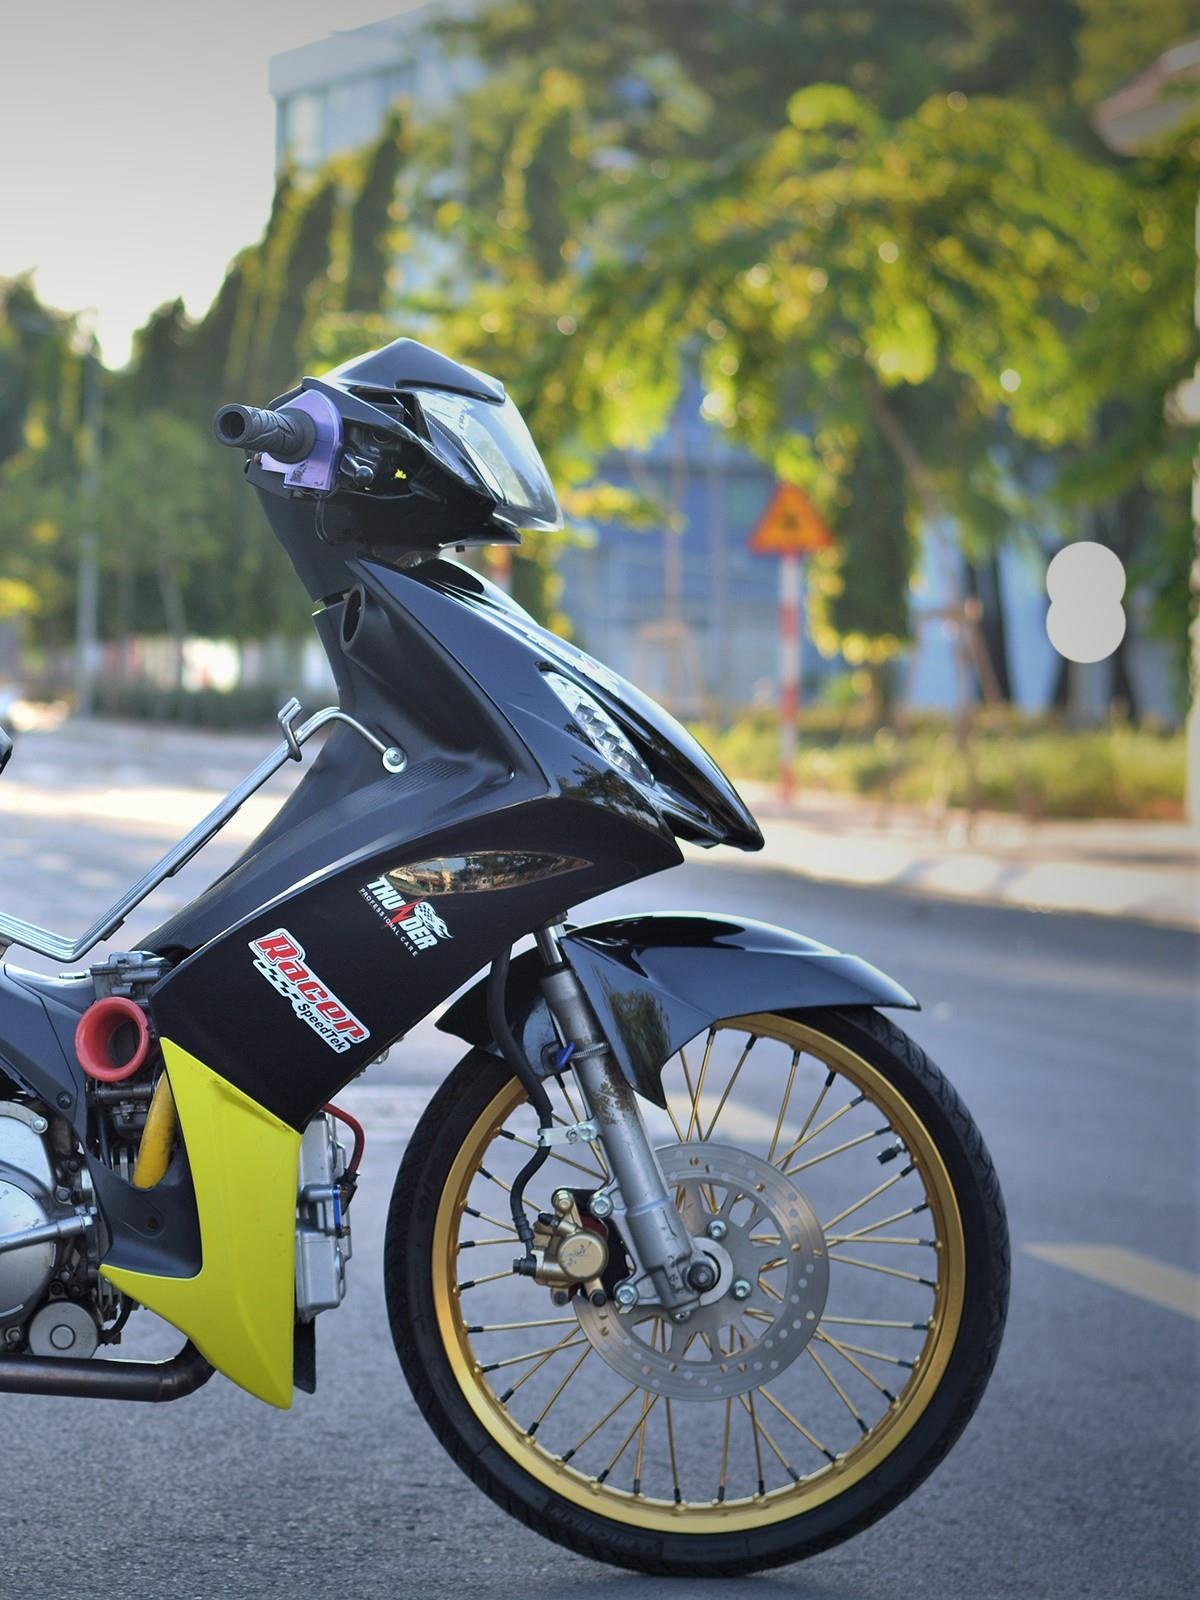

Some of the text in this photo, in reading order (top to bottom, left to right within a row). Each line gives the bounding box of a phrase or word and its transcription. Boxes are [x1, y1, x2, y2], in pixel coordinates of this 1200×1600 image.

[359, 887, 419, 957] PROFESSIONAL CARE
[366, 875, 439, 951] THUNDER
[255, 933, 367, 1041] Racer
[297, 1003, 347, 1050] SpeedTek
